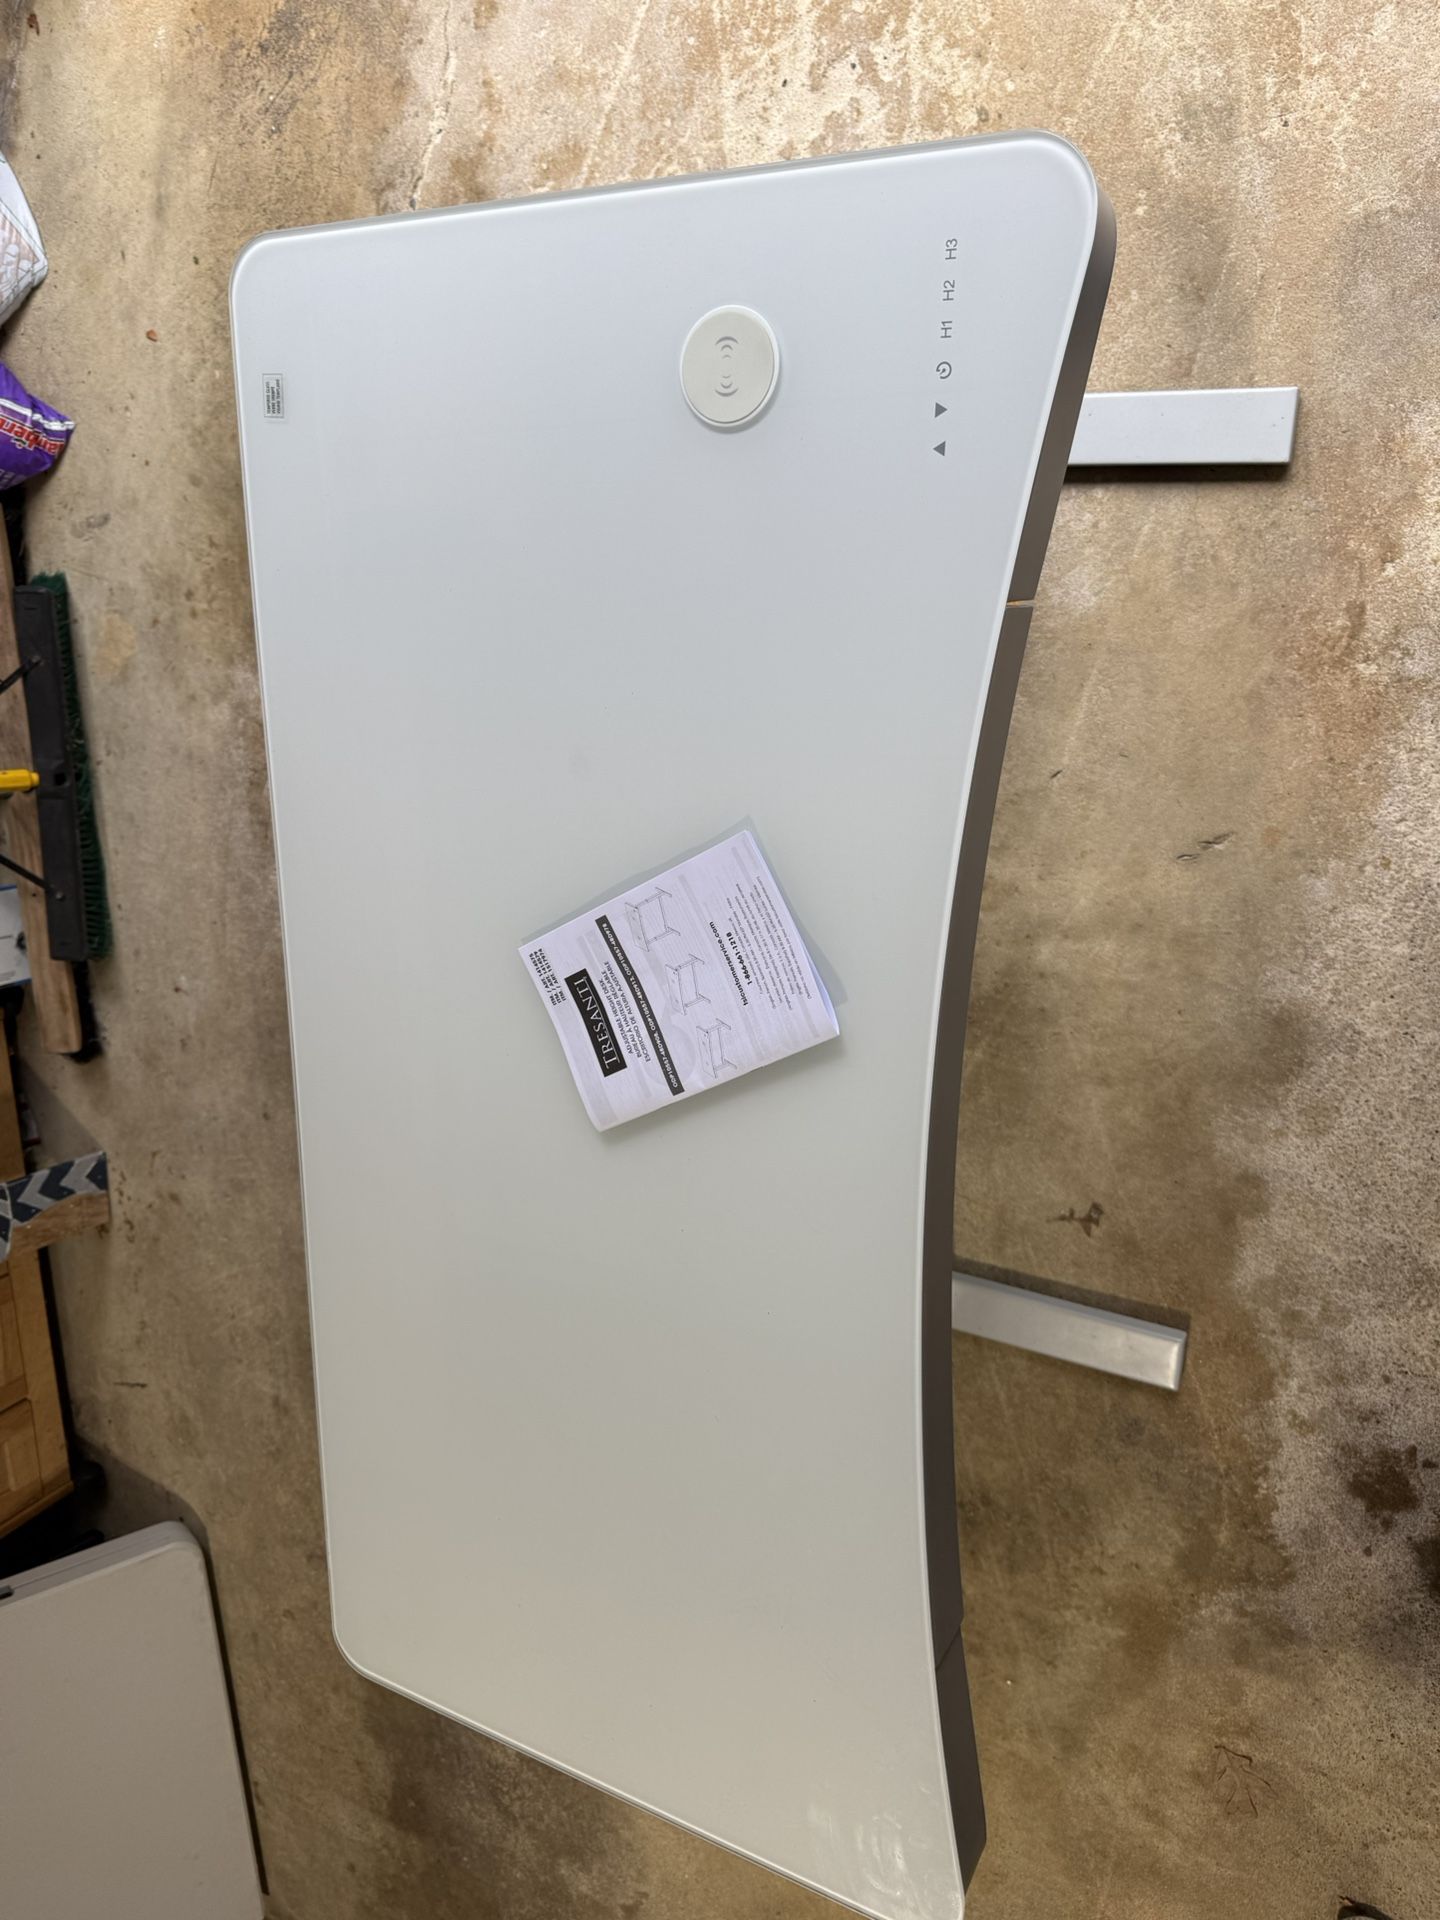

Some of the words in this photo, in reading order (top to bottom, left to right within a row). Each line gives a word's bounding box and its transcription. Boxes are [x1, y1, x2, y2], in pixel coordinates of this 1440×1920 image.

[945, 238, 958, 260] H3
[942, 280, 956, 301] H2
[940, 321, 953, 339] H1
[708, 920, 749, 1006] tsicustomerservice.com
[725, 931, 753, 985] 1-866-661-1218
[598, 977, 609, 994] DESK
[603, 960, 623, 992] AJUSTABLE
[605, 993, 618, 1017] HEIGHT
[615, 999, 630, 1027] HAUTEUR
[619, 992, 633, 1015] ALTURA
[572, 977, 620, 1068] TRESANTI
[629, 1015, 636, 1024] DE
[615, 1017, 634, 1055] ADJUSTABLE
[628, 1033, 642, 1058] BUREAU
[632, 1024, 651, 1062] ESCRITORIO
